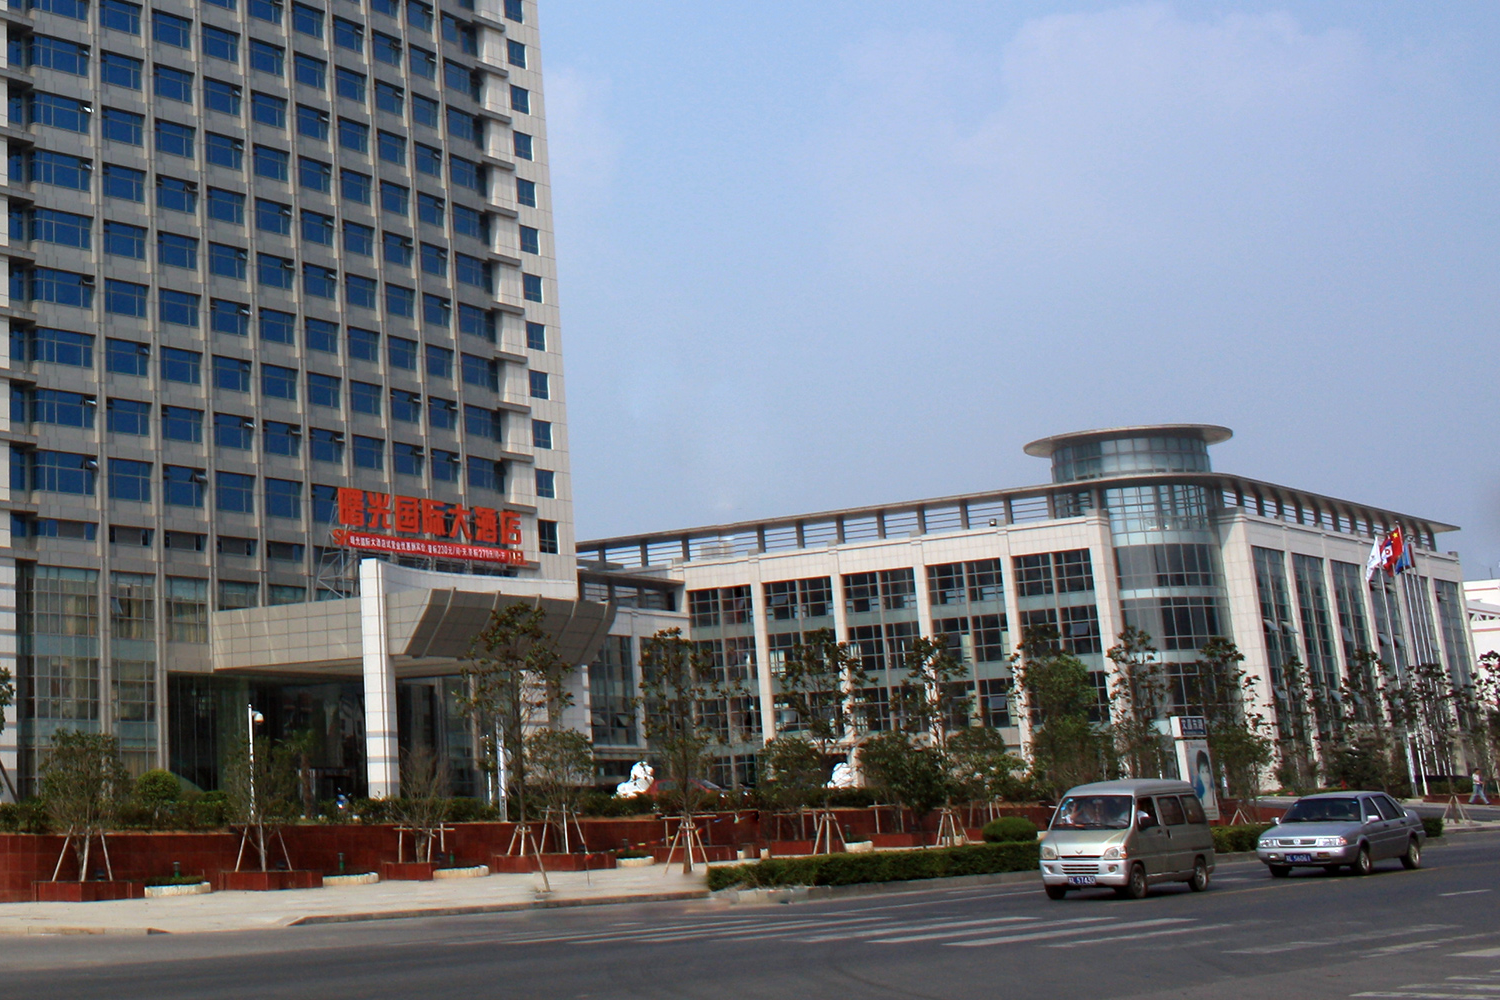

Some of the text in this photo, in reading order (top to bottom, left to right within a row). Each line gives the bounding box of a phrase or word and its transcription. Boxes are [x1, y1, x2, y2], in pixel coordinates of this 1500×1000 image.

[338, 487, 522, 546] 曙光国际大酒店
